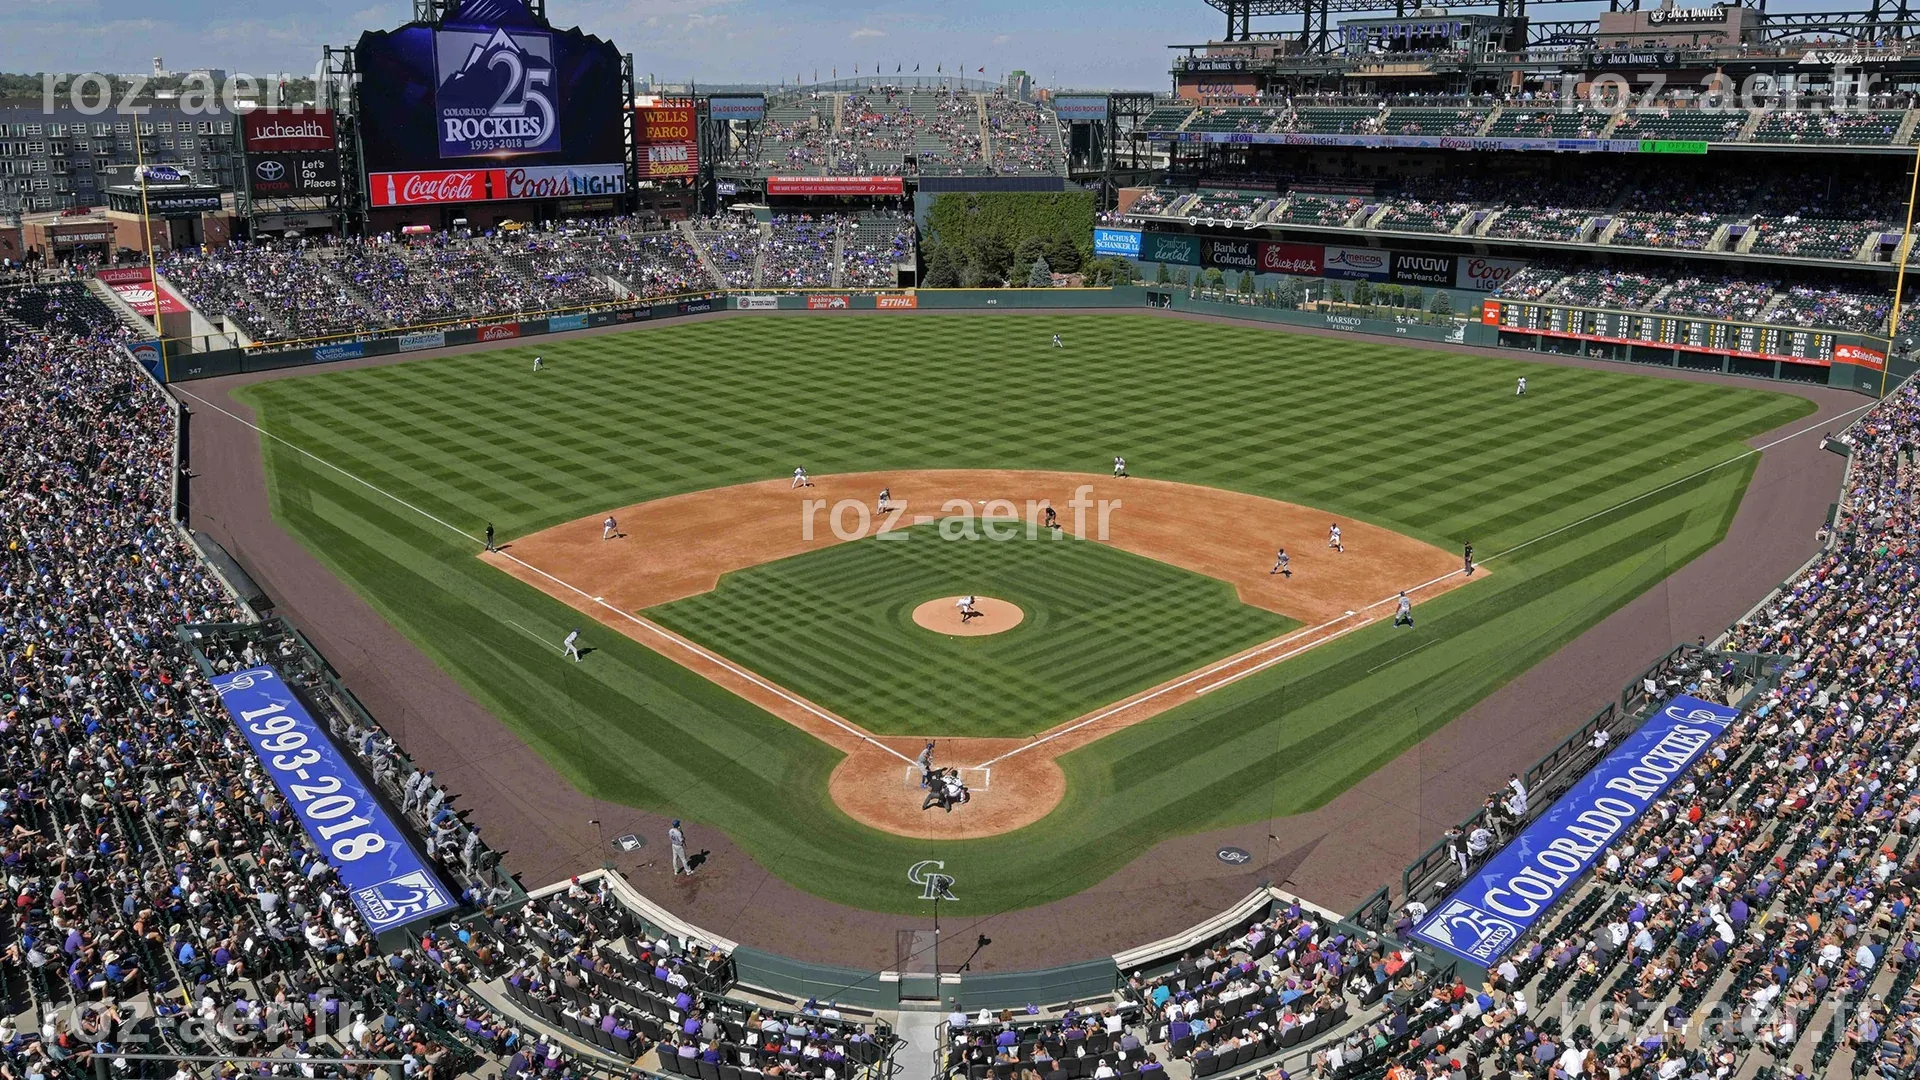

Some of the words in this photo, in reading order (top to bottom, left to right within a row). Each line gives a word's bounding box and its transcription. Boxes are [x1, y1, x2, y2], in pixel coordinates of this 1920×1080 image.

[1668, 7, 1689, 18] JACK
[1608, 54, 1627, 63] JACK
[1629, 53, 1658, 63] DANIEL'S
[1821, 51, 1864, 64] Silver
[1198, 61, 1211, 70] JACK
[1197, 80, 1234, 93] Coors
[488, 50, 555, 148] 25
[443, 108, 488, 117] COLORADO
[644, 111, 688, 122] WELLS
[256, 120, 323, 138] uchealth
[444, 117, 541, 142] ROCKIES
[646, 126, 688, 138] FARGO
[471, 138, 522, 150] 1993-2018
[1284, 134, 1312, 145] Coors
[1313, 137, 1337, 145] LIGHT
[1439, 136, 1473, 149] Coors
[1473, 140, 1502, 149] LIGHT
[648, 145, 688, 161] KING
[302, 160, 325, 169] Let's
[107, 167, 118, 175] 485
[149, 171, 181, 181] TOYOTA
[302, 170, 316, 179] Go
[304, 180, 337, 188] Places
[403, 173, 476, 201] Coca-Cola
[506, 168, 570, 198] Coors
[573, 174, 625, 195] LIGHT
[147, 198, 219, 208] TUNDRA
[1102, 233, 1129, 243] BACHUS
[1130, 234, 1137, 243] &
[1096, 239, 1131, 250] SCHANKER
[1213, 242, 1235, 252] Bank
[1238, 243, 1248, 254] of
[1155, 247, 1190, 262] dental
[1265, 248, 1317, 272] Chick-fil-A
[1213, 254, 1256, 267] Colorado
[1397, 256, 1449, 272] ARROW
[104, 270, 143, 281] uchealth
[1397, 272, 1412, 280] Five
[1412, 272, 1433, 282] Years
[1433, 274, 1447, 283] Out
[1476, 279, 1498, 290] LIG
[687, 303, 711, 311] Fanatics
[880, 298, 913, 307] STIHL
[1326, 315, 1361, 326] MARSICO
[483, 331, 496, 340] Red
[496, 330, 514, 339] Robin
[322, 347, 344, 355] BURNS
[240, 702, 386, 861] 1993-2018
[1484, 797, 1635, 919] COLORADO
[1605, 724, 1712, 801] ROCKIES
[358, 888, 389, 920] ROCKIES
[368, 890, 424, 924] 25
[1451, 910, 1517, 941] 25
[1472, 926, 1511, 959] ROCKIES
